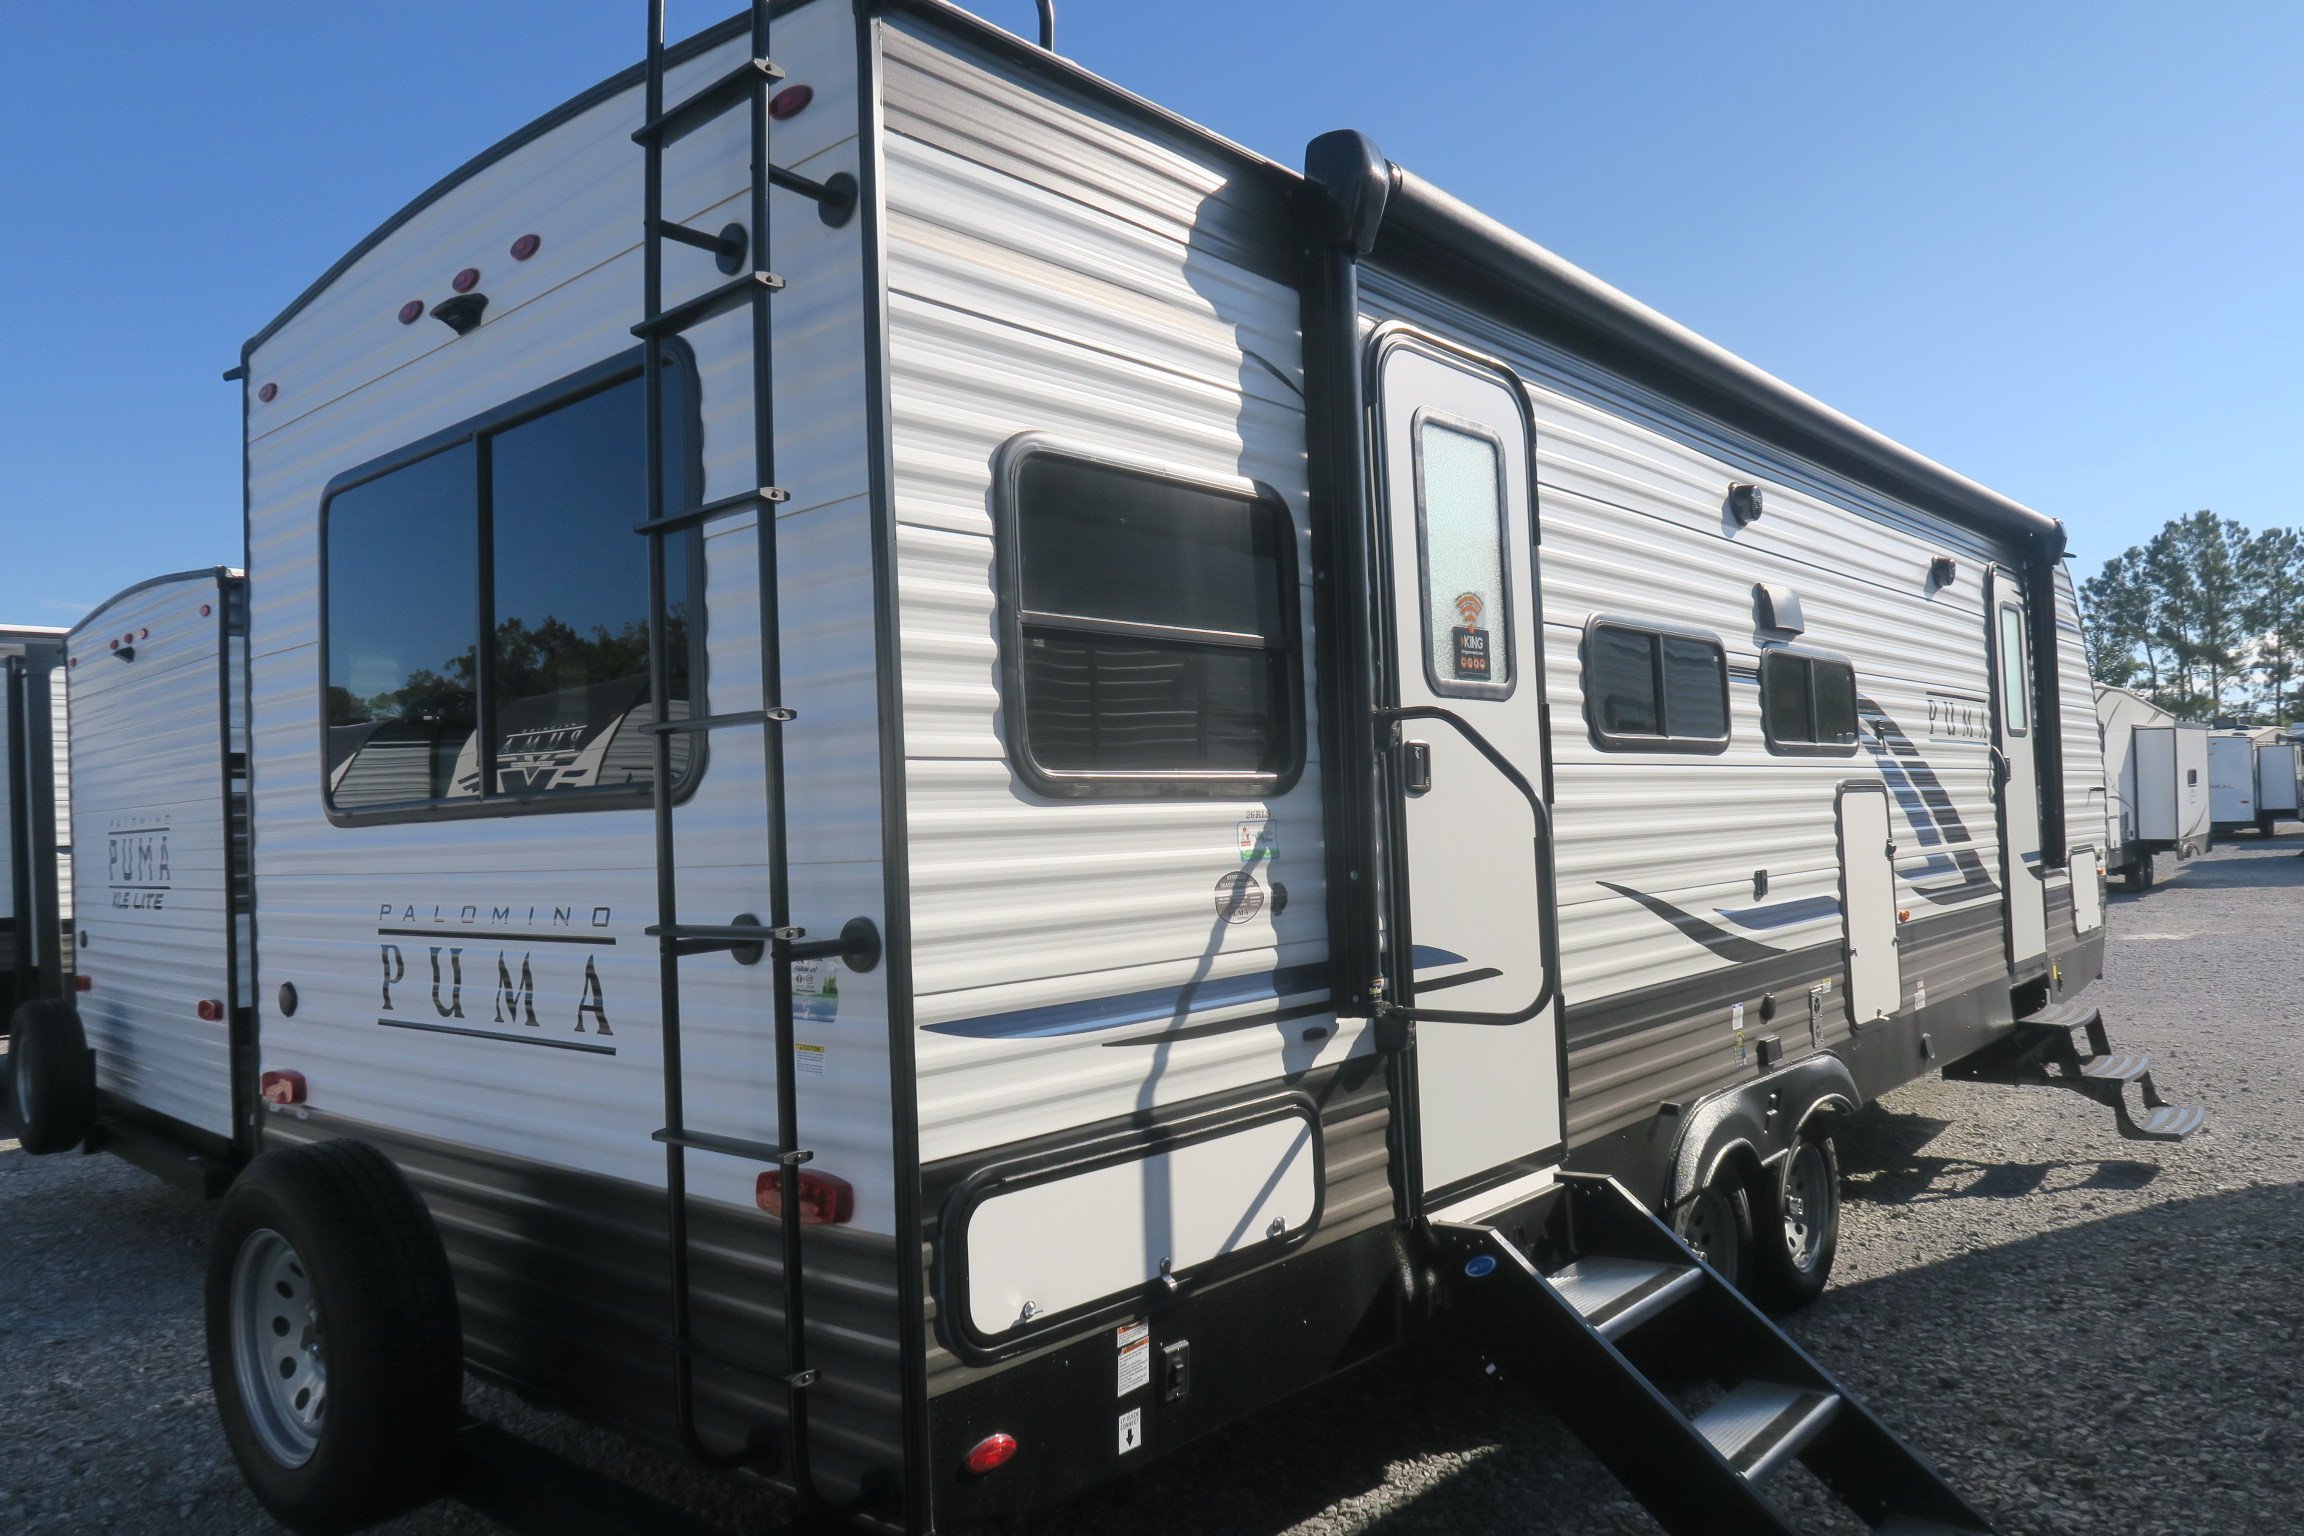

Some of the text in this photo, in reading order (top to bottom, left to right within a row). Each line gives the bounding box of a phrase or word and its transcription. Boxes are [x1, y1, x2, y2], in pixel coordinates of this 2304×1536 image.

[1464, 635, 1483, 649] KING
[1926, 699, 1987, 738] PUMA
[109, 836, 170, 881] PUMA
[133, 893, 164, 910] LITE
[379, 903, 611, 927] PALOMINO
[381, 944, 614, 1036] PUMA
